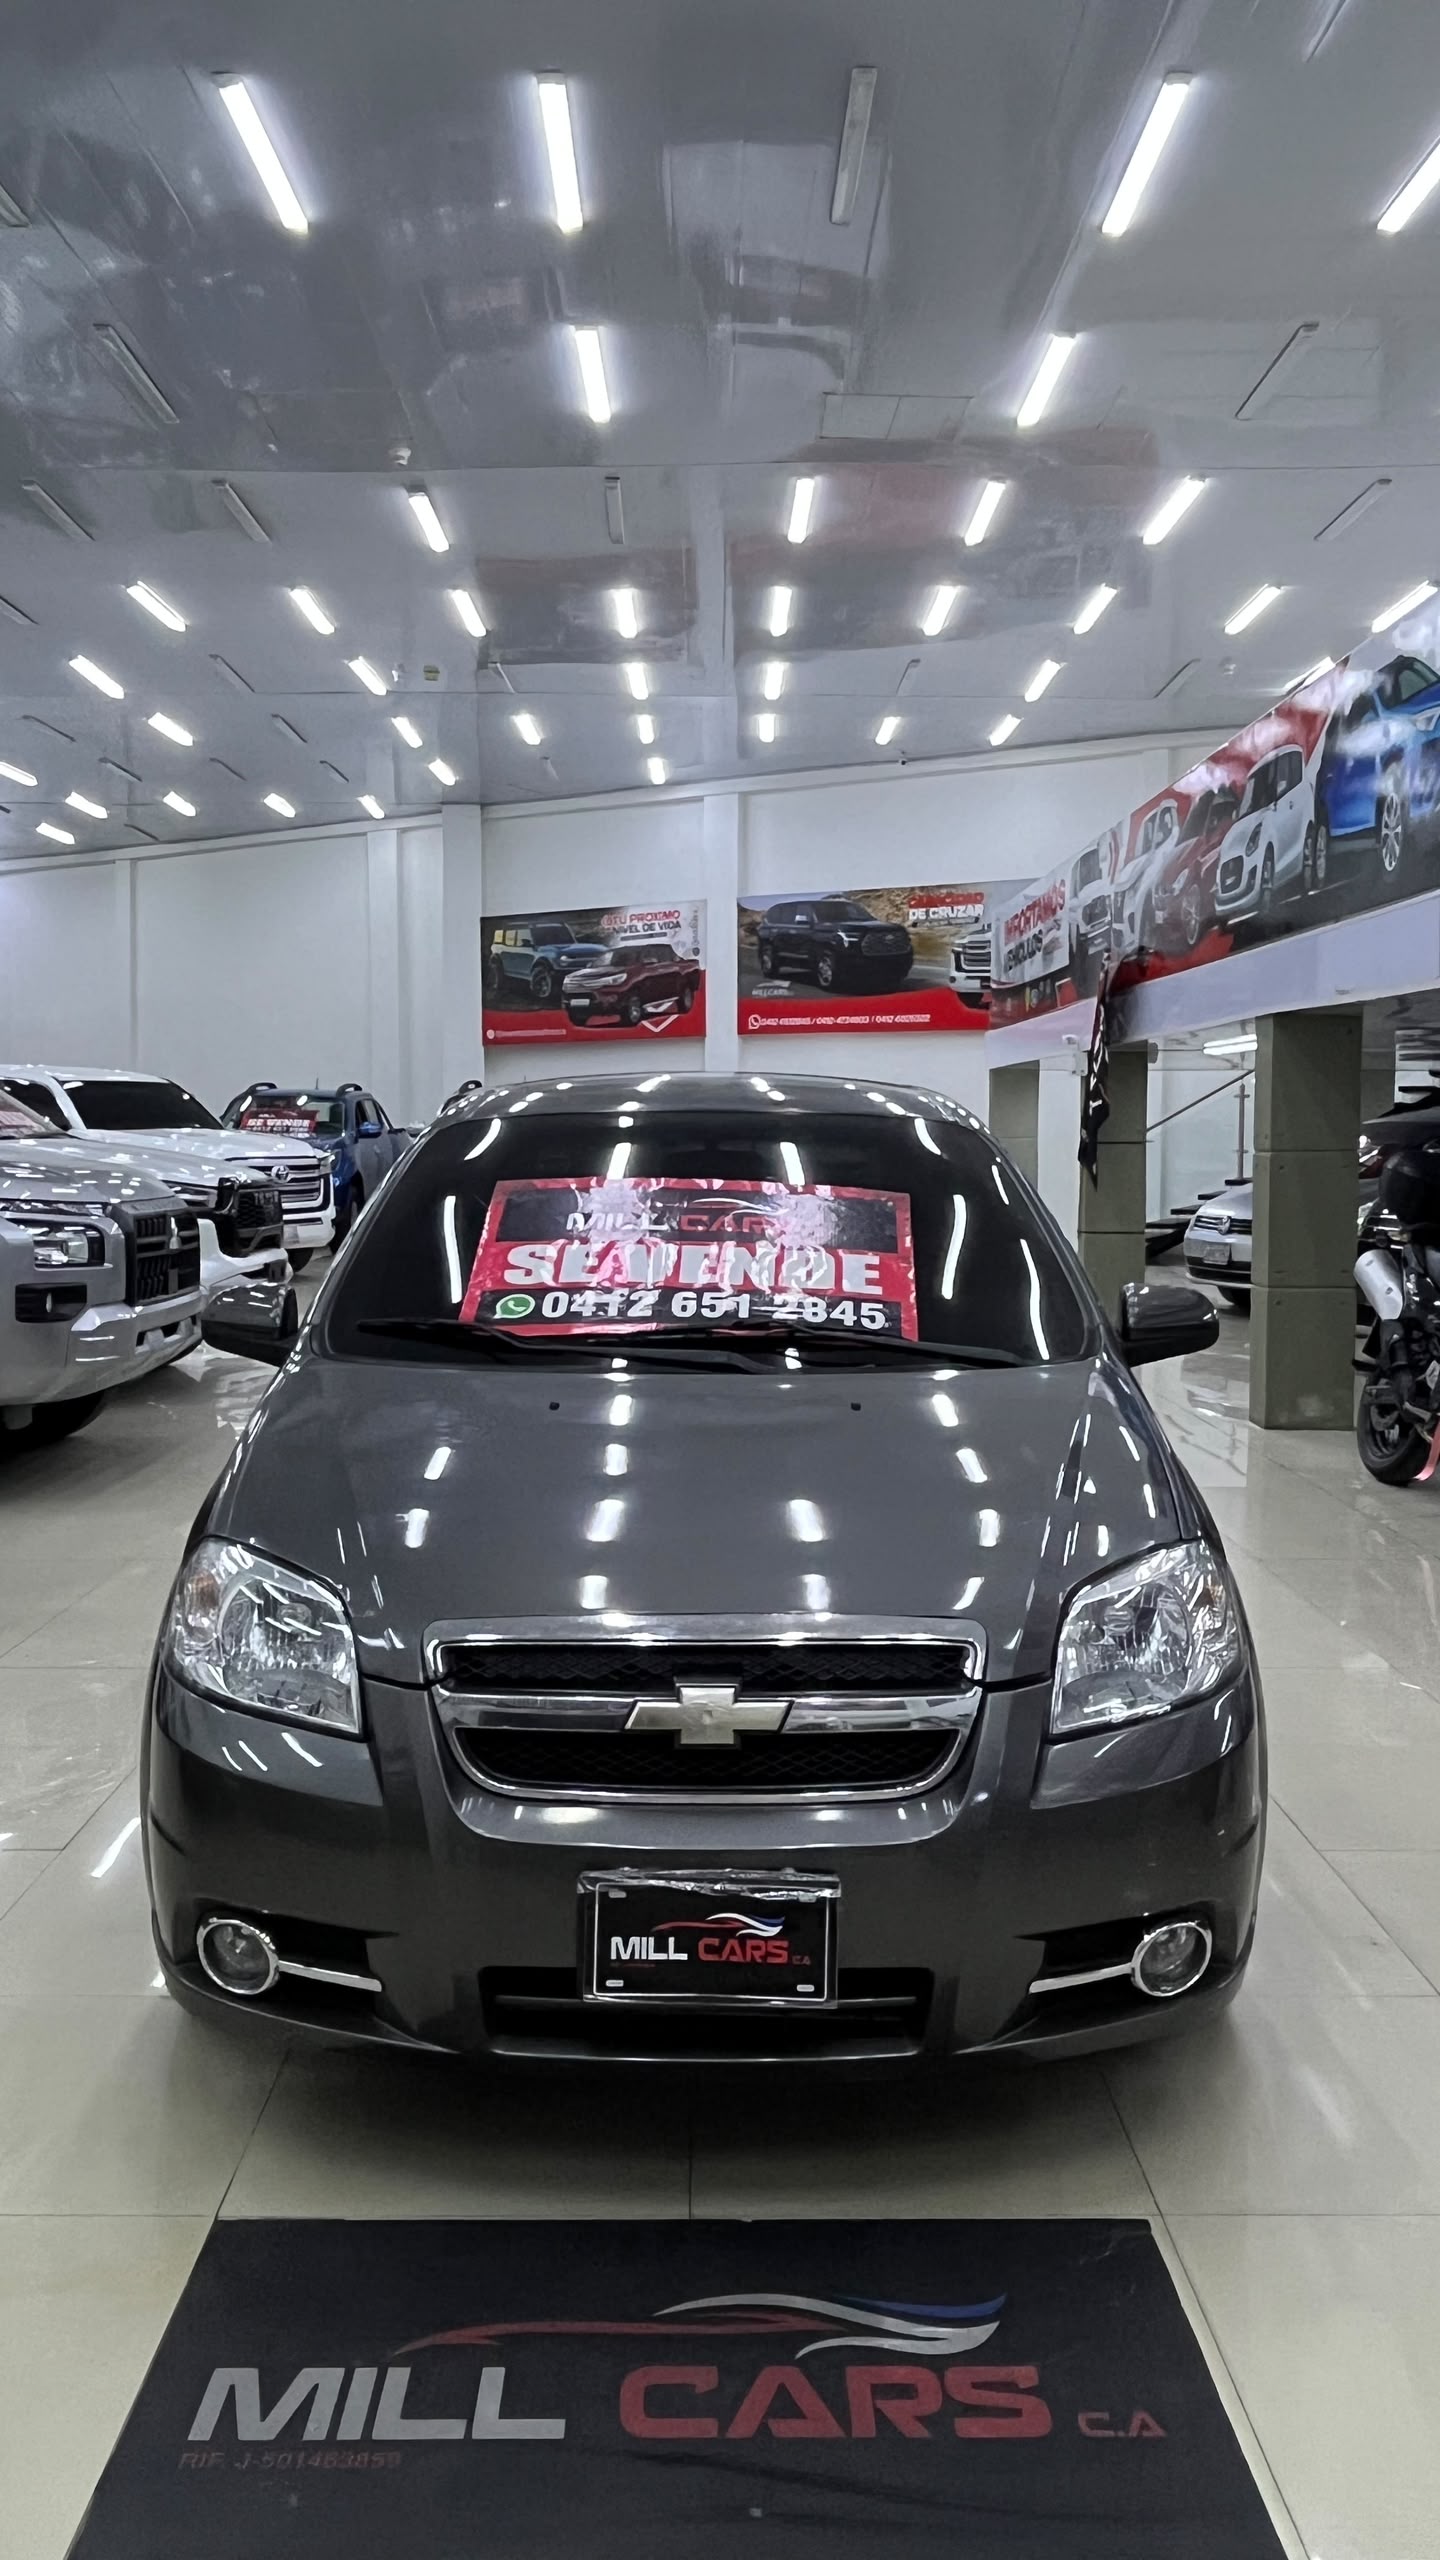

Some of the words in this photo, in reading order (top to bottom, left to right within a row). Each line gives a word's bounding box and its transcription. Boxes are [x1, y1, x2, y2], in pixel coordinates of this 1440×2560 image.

[642, 922, 656, 932] DE
[658, 920, 682, 930] VIDA
[671, 1291, 751, 1318] 651
[610, 1935, 689, 1961] MILL
[697, 1937, 790, 1964] CARS
[187, 2365, 567, 2441] MILL
[619, 2364, 1053, 2439] CARS
